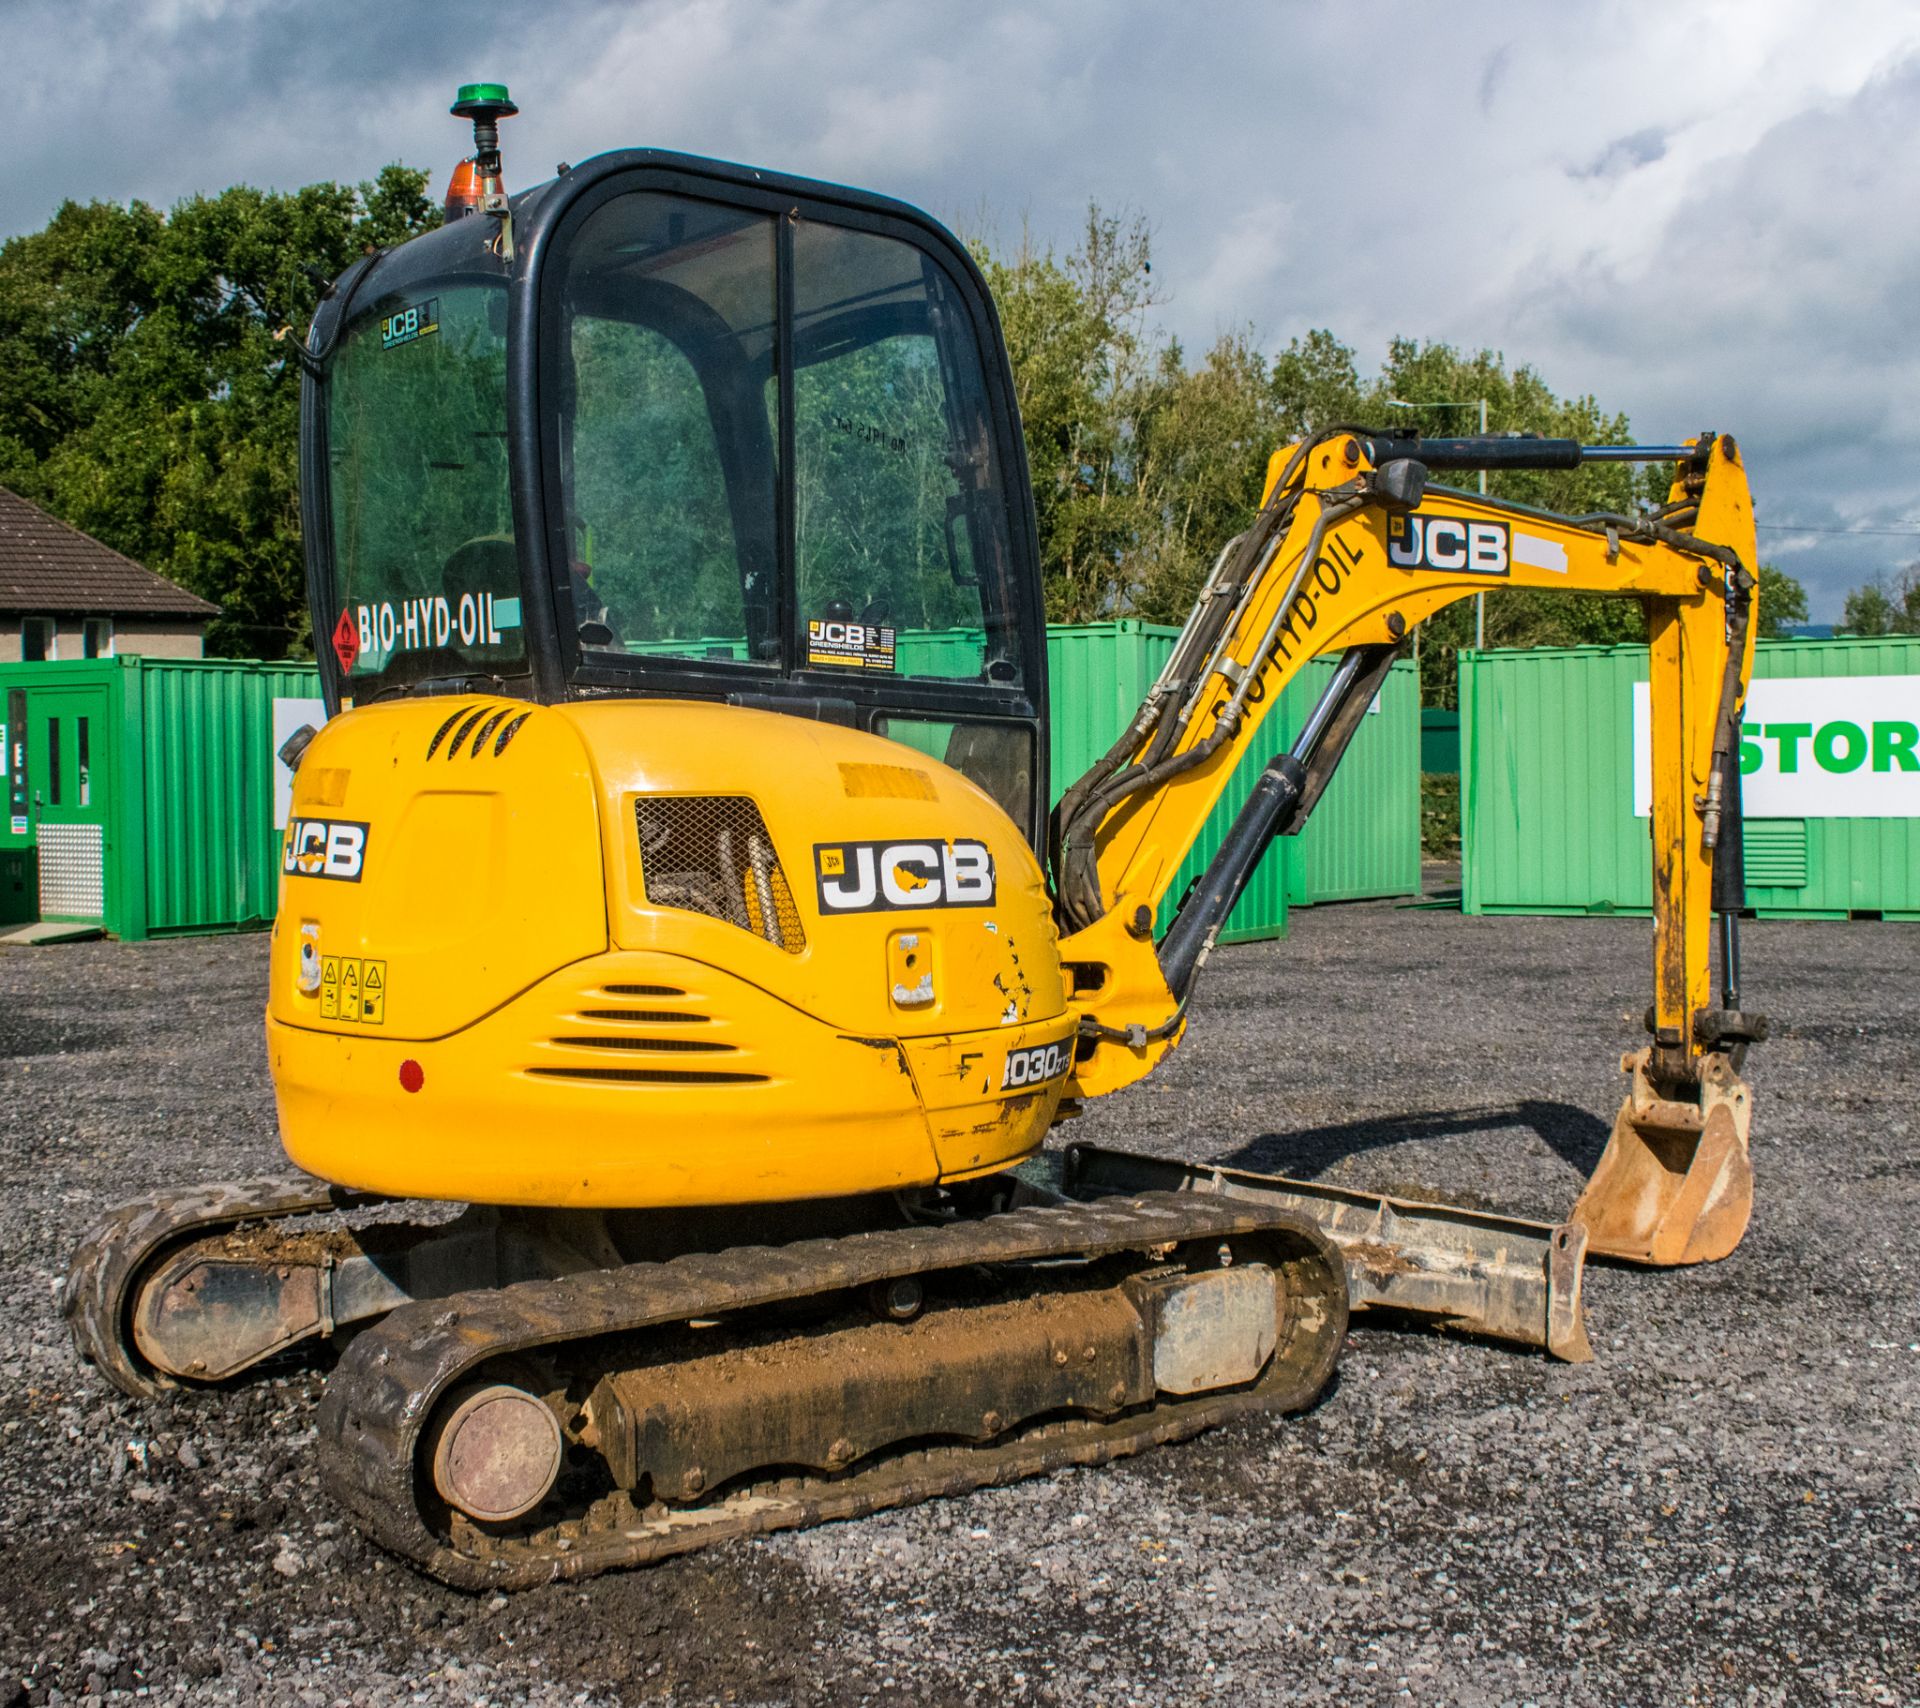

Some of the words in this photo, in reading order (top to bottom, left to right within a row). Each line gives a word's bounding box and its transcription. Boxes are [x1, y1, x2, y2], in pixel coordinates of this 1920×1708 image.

[383, 308, 418, 341] JCB
[1390, 517, 1508, 572] JCB
[358, 592, 501, 653] BIO-HYD-OIL
[809, 622, 865, 644] JCB
[809, 640, 865, 651] GREENSHIELDS
[285, 822, 365, 877] JCB
[823, 845, 993, 908] JCB
